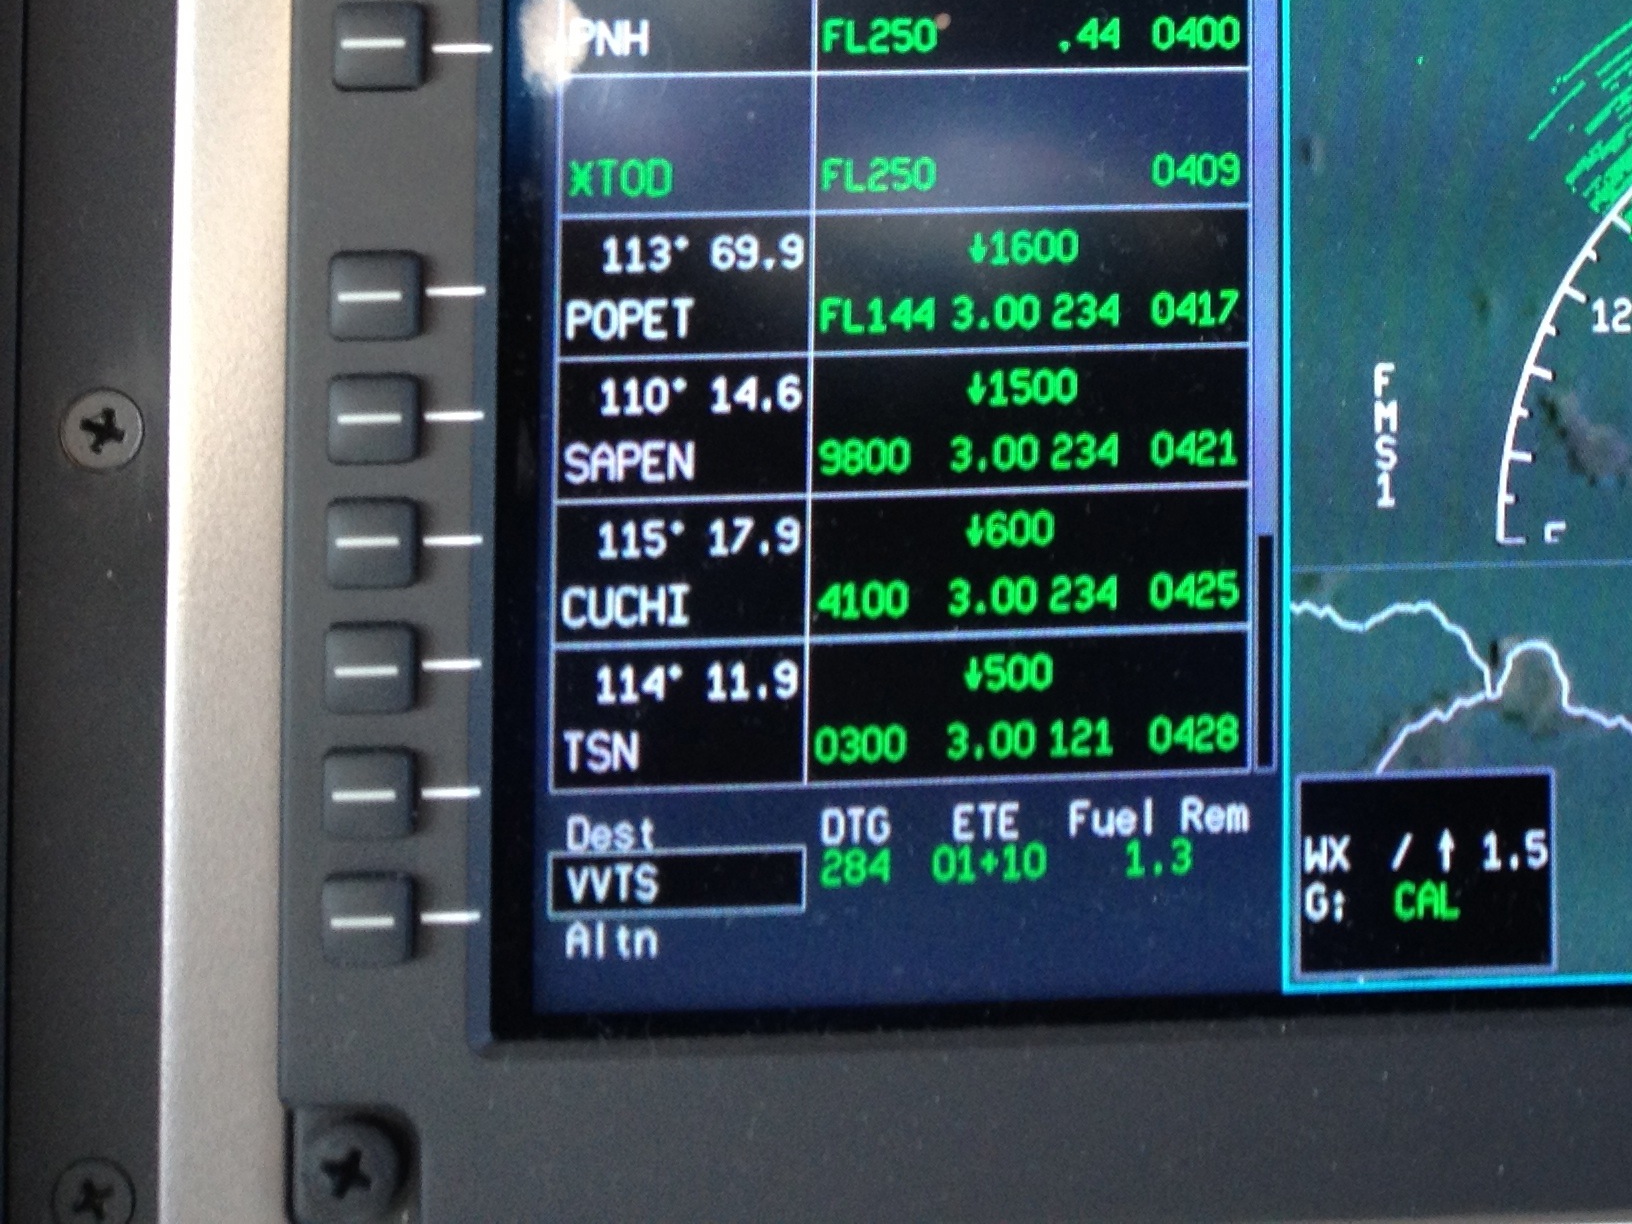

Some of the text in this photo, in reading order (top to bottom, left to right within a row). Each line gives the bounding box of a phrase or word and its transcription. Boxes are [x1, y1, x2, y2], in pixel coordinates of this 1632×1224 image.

[570, 17, 1241, 56] PNH FL250 .44 0400
[569, 154, 1241, 197] XTOD FL250 0409
[709, 235, 805, 271] 69.9
[990, 229, 1079, 265] 1600
[566, 292, 1240, 340] POPET FL144 3.00 234 0417
[1591, 299, 1632, 334] 12
[711, 377, 803, 413] 14.6
[990, 369, 1078, 404] 1500
[564, 432, 1237, 484] SAPEN 9800 3.00 234 0421
[707, 518, 800, 556] 17.9
[984, 510, 1055, 547] 600
[562, 572, 1240, 628] CUCHI 4100 3.00 234 0425
[707, 661, 798, 700] 11.9
[983, 654, 1053, 690] 500
[563, 715, 1240, 772] TSN 0300 3.00 121 0428
[567, 797, 1250, 852] Dest DTG ETE Fuel Rem
[567, 839, 1193, 904] VVTS 284 01+10 1.3
[1303, 835, 1352, 873] WX
[1482, 828, 1549, 871] 1.5
[1393, 879, 1460, 922] CAL
[566, 924, 659, 958] Altn
